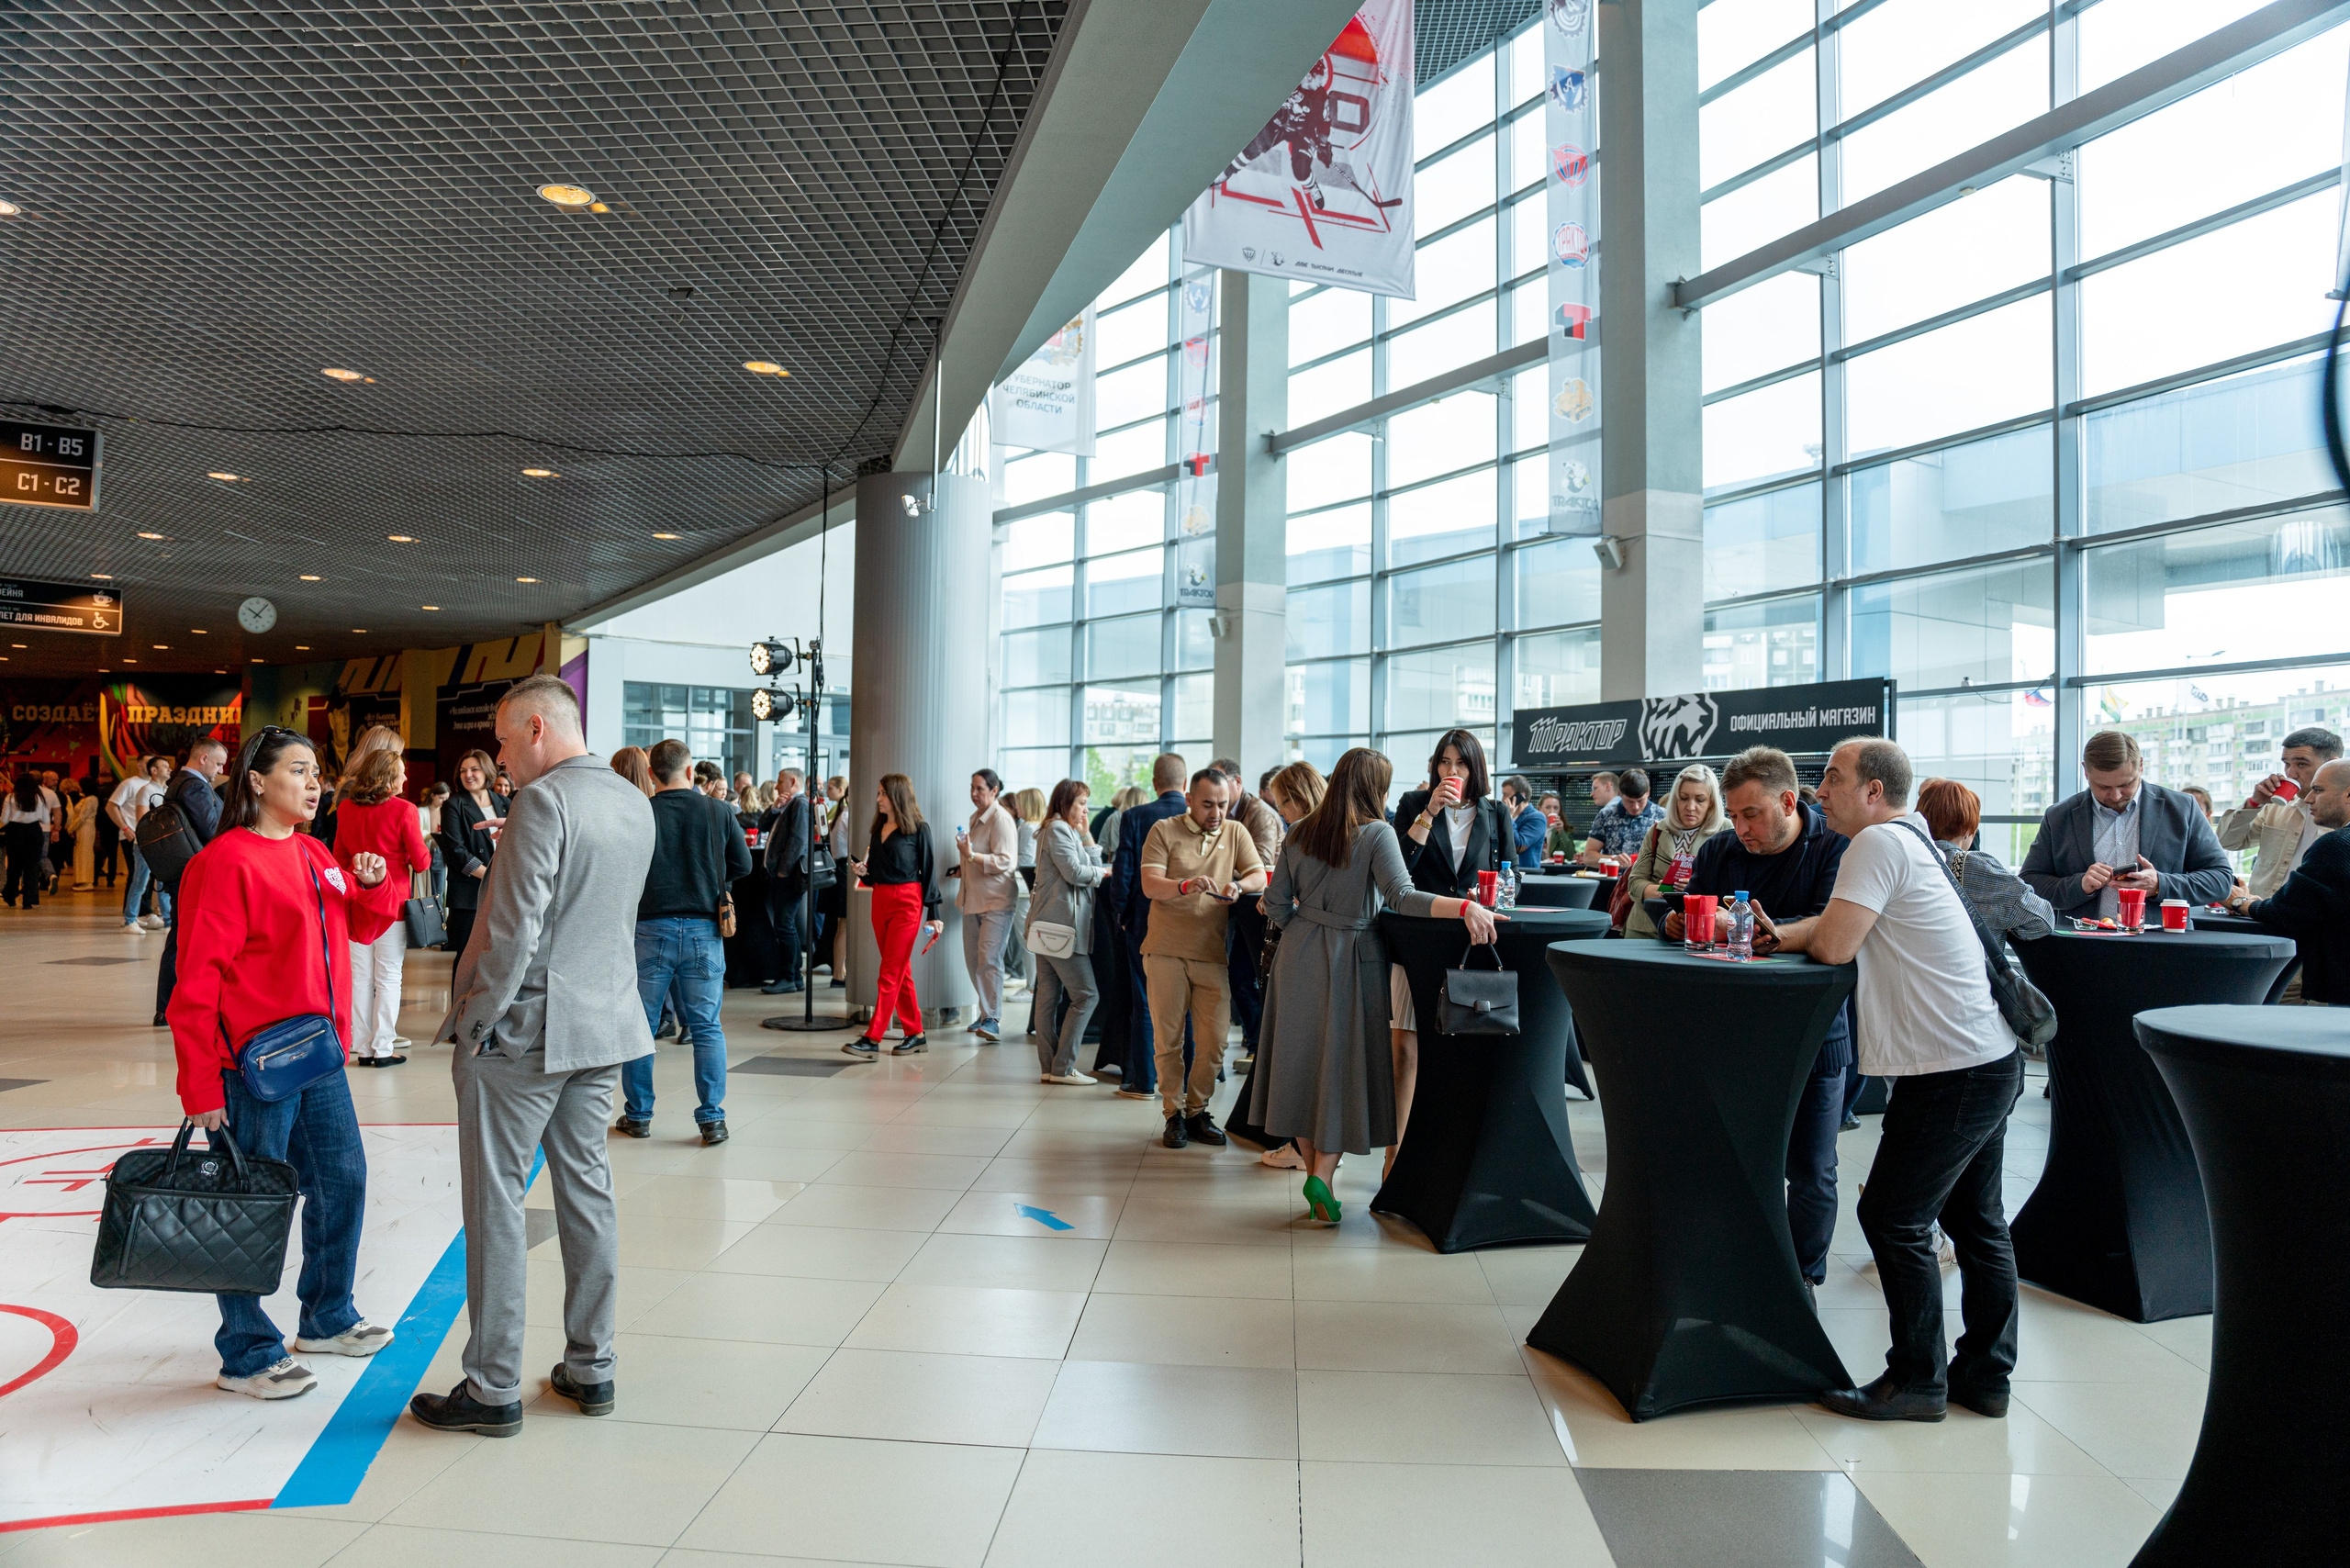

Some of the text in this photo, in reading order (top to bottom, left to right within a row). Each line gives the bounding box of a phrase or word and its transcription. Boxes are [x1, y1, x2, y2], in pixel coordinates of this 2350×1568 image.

[1002, 384, 1075, 404] ЧЕЛЯБИНСКОЙ
[1016, 398, 1063, 415] ОБЛАСТИ
[0, 587, 24, 598] ЕЙНЯ
[15, 612, 33, 622] ДЛЯ
[34, 614, 84, 626] ИНВАЛИДОВ
[12, 702, 99, 723] СОЗДАЁ
[1730, 706, 1876, 733] ОФИЦИАЛЬНЫЙ МАГАЗИН
